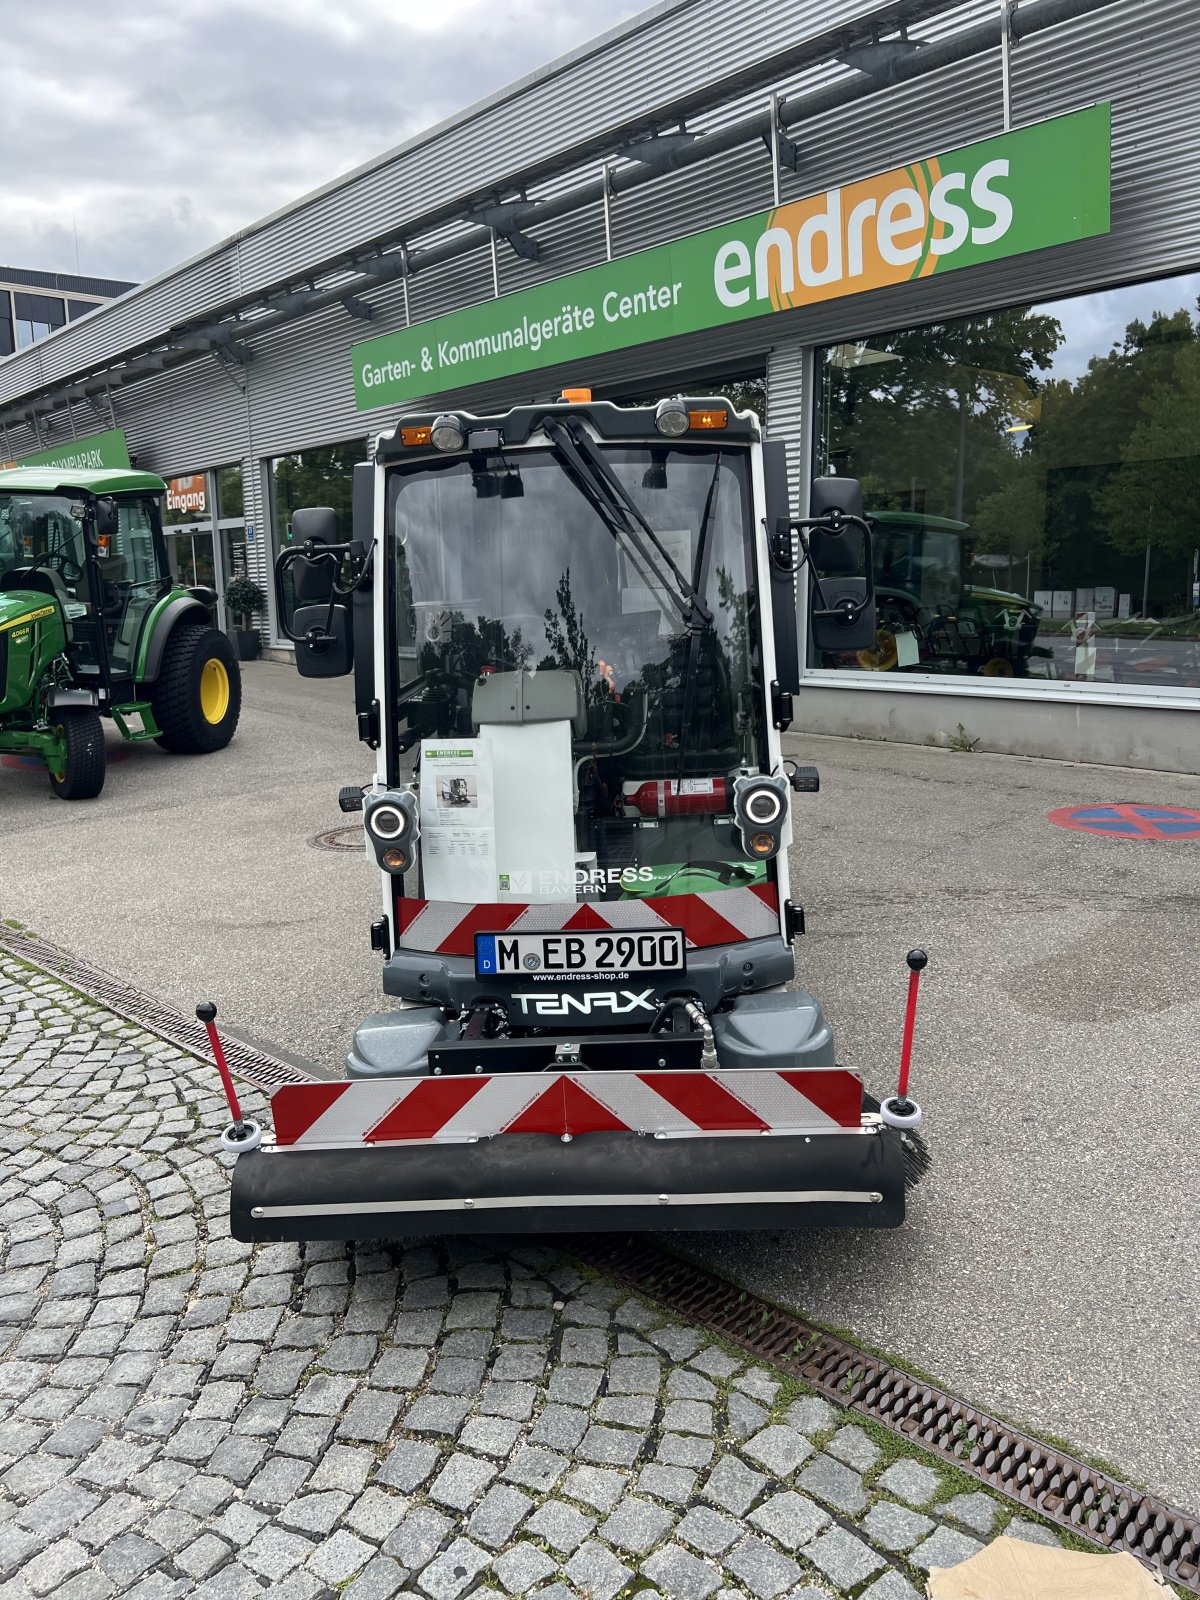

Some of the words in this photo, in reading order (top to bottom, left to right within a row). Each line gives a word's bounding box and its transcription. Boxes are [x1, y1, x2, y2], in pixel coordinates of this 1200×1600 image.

[714, 159, 1013, 307] endress
[362, 360, 416, 387] Garten-
[421, 347, 434, 372] &
[438, 305, 595, 368] Kommunalgeräte
[602, 282, 682, 322] Center
[166, 489, 205, 514] Eingang
[541, 866, 653, 884] ENDRESS
[541, 885, 606, 894] BAYERN
[483, 960, 490, 969] D
[498, 939, 520, 970] M
[542, 937, 586, 970] EB
[595, 935, 678, 968] 2900
[532, 972, 629, 981] www.endress-shop.de
[511, 988, 656, 1015] TENAX
